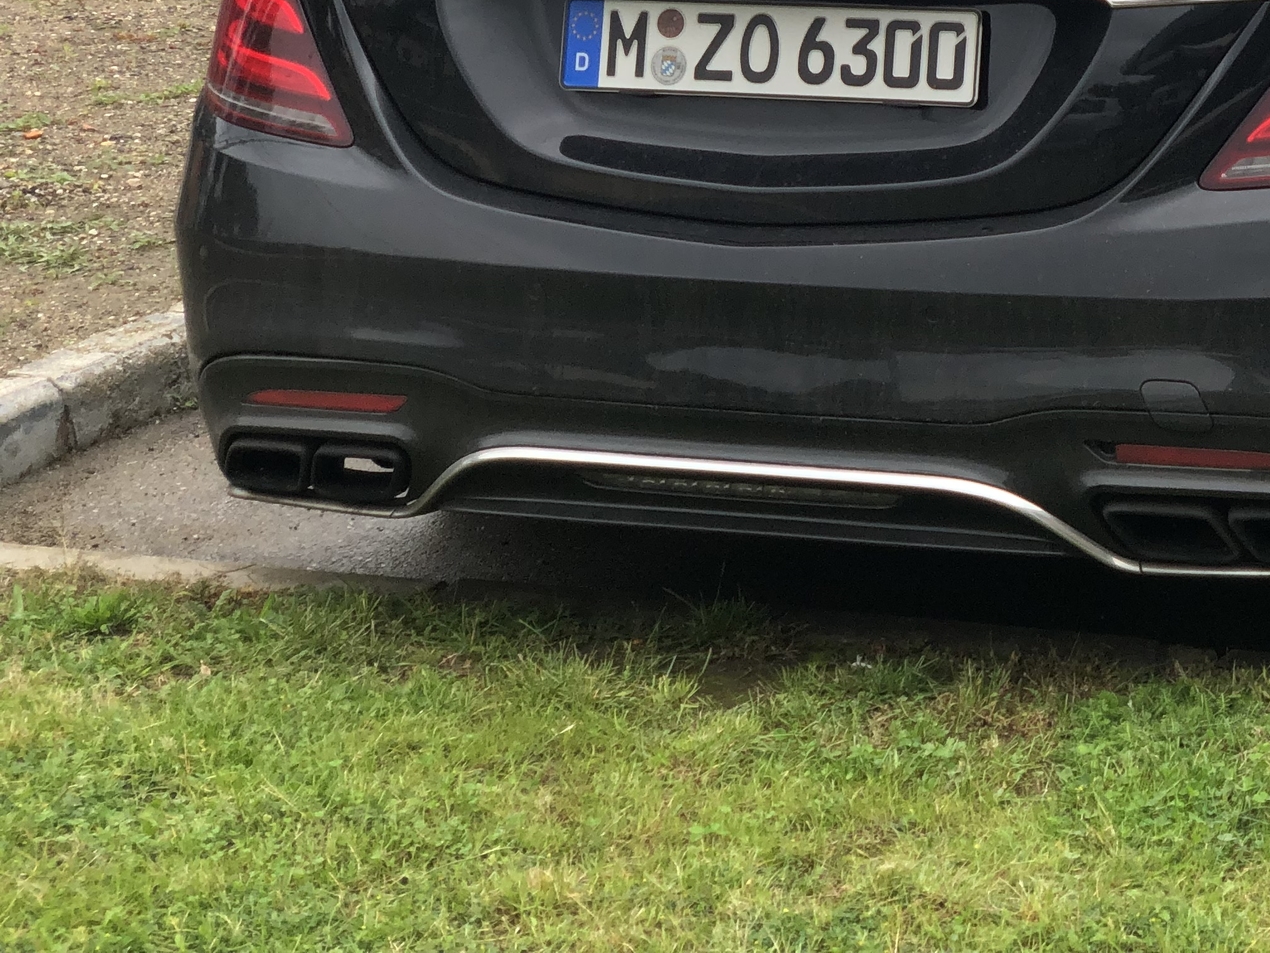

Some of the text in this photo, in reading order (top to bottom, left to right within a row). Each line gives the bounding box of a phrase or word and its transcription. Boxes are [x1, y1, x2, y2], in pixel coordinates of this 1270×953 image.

[574, 51, 589, 72] D
[606, 10, 969, 91] M ZO 6300
